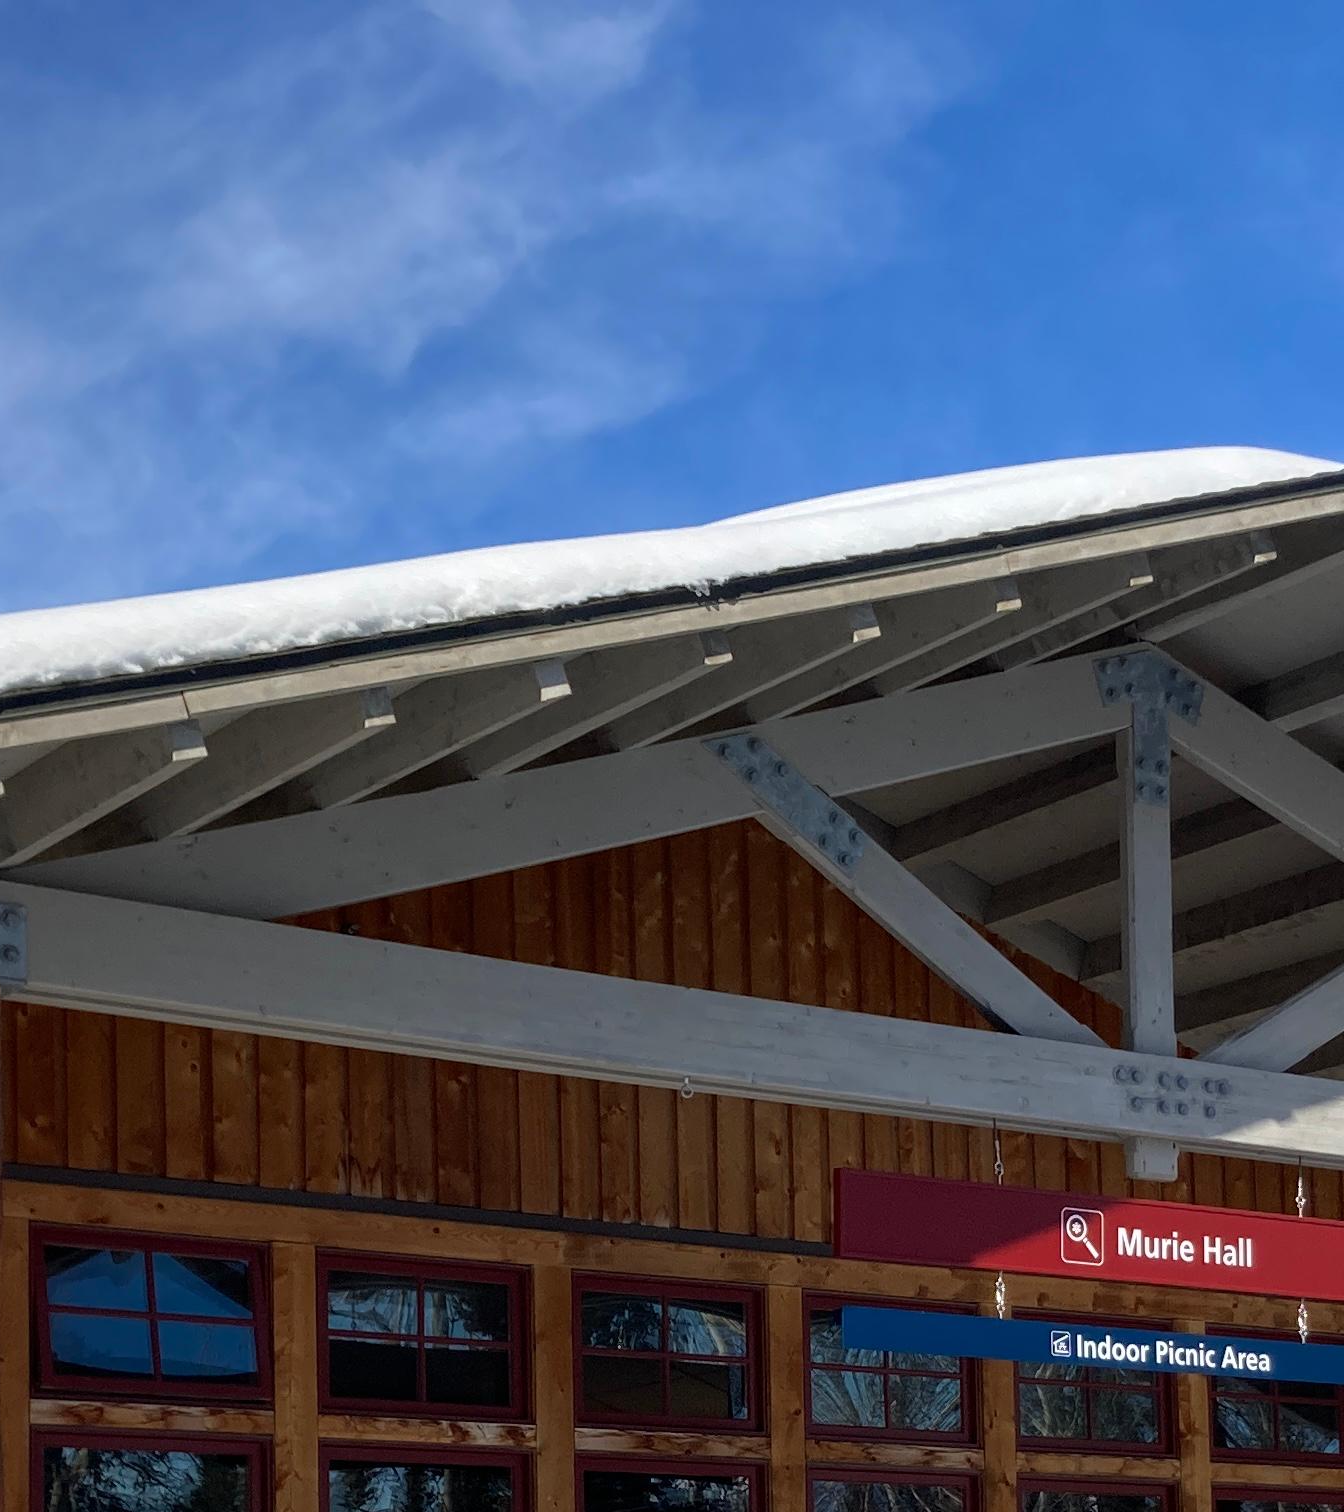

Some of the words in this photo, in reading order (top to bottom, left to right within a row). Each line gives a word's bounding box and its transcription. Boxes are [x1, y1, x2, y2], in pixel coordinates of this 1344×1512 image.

[1117, 1226, 1195, 1262] Murie
[1203, 1235, 1253, 1268] Hall
[1076, 1334, 1149, 1363] Indoor
[1155, 1341, 1217, 1369] Picnic
[1221, 1346, 1272, 1372] Area
